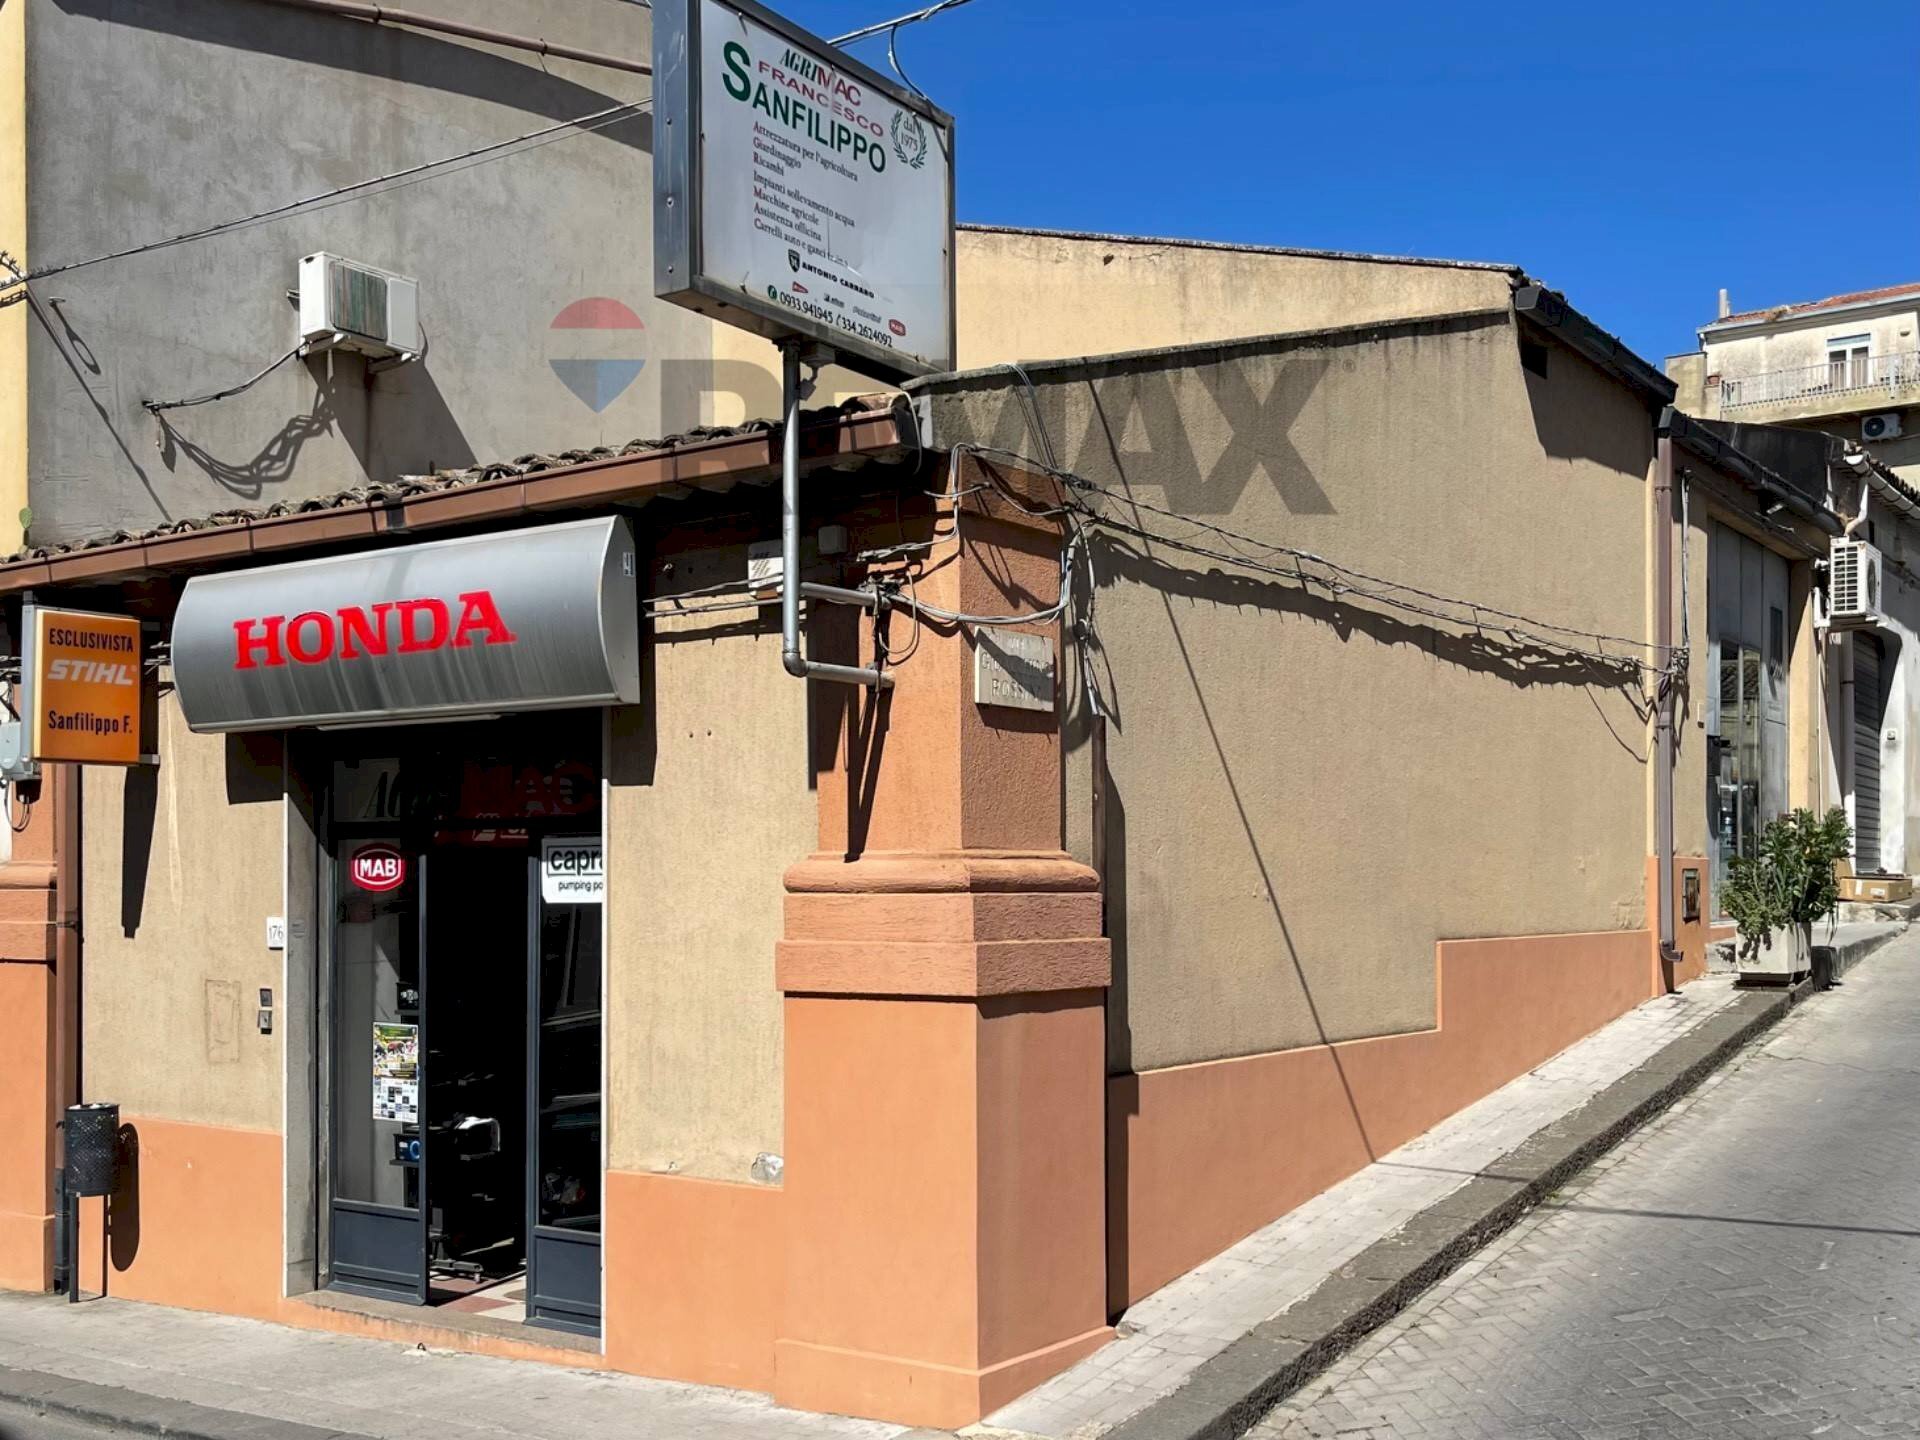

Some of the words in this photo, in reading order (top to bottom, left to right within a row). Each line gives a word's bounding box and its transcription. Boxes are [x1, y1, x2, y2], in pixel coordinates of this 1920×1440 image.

[779, 48, 862, 107] AGRIMAC
[722, 41, 886, 173] SANFILIPPO
[758, 60, 884, 138] FRANCESCO
[903, 116, 916, 135] dal
[753, 121, 801, 153] Attrezzatura
[802, 147, 815, 160] per
[816, 151, 858, 182] l'agricoltura
[753, 136, 802, 169] Giardinaggio
[753, 151, 784, 176] Ricambi
[753, 169, 786, 194] Impianti
[787, 188, 834, 218] sollevamento
[834, 211, 856, 228] acqua
[753, 185, 790, 212] Macchine
[791, 206, 820, 226] agricole
[753, 201, 794, 229] Assistenza
[794, 221, 822, 242] officina
[753, 217, 783, 240] Carrelli
[784, 233, 801, 247] auto
[802, 261, 838, 283] ANTONIO
[839, 278, 875, 299] CARRARO
[48, 627, 134, 653] ESCLUSIVISTA
[232, 590, 518, 670] HONDA
[47, 658, 134, 686] STIHL
[48, 709, 119, 736] Sanfilippo
[122, 715, 133, 734] F.
[360, 858, 397, 877] MAB
[558, 880, 592, 893] pumping
[268, 924, 284, 941] 176
